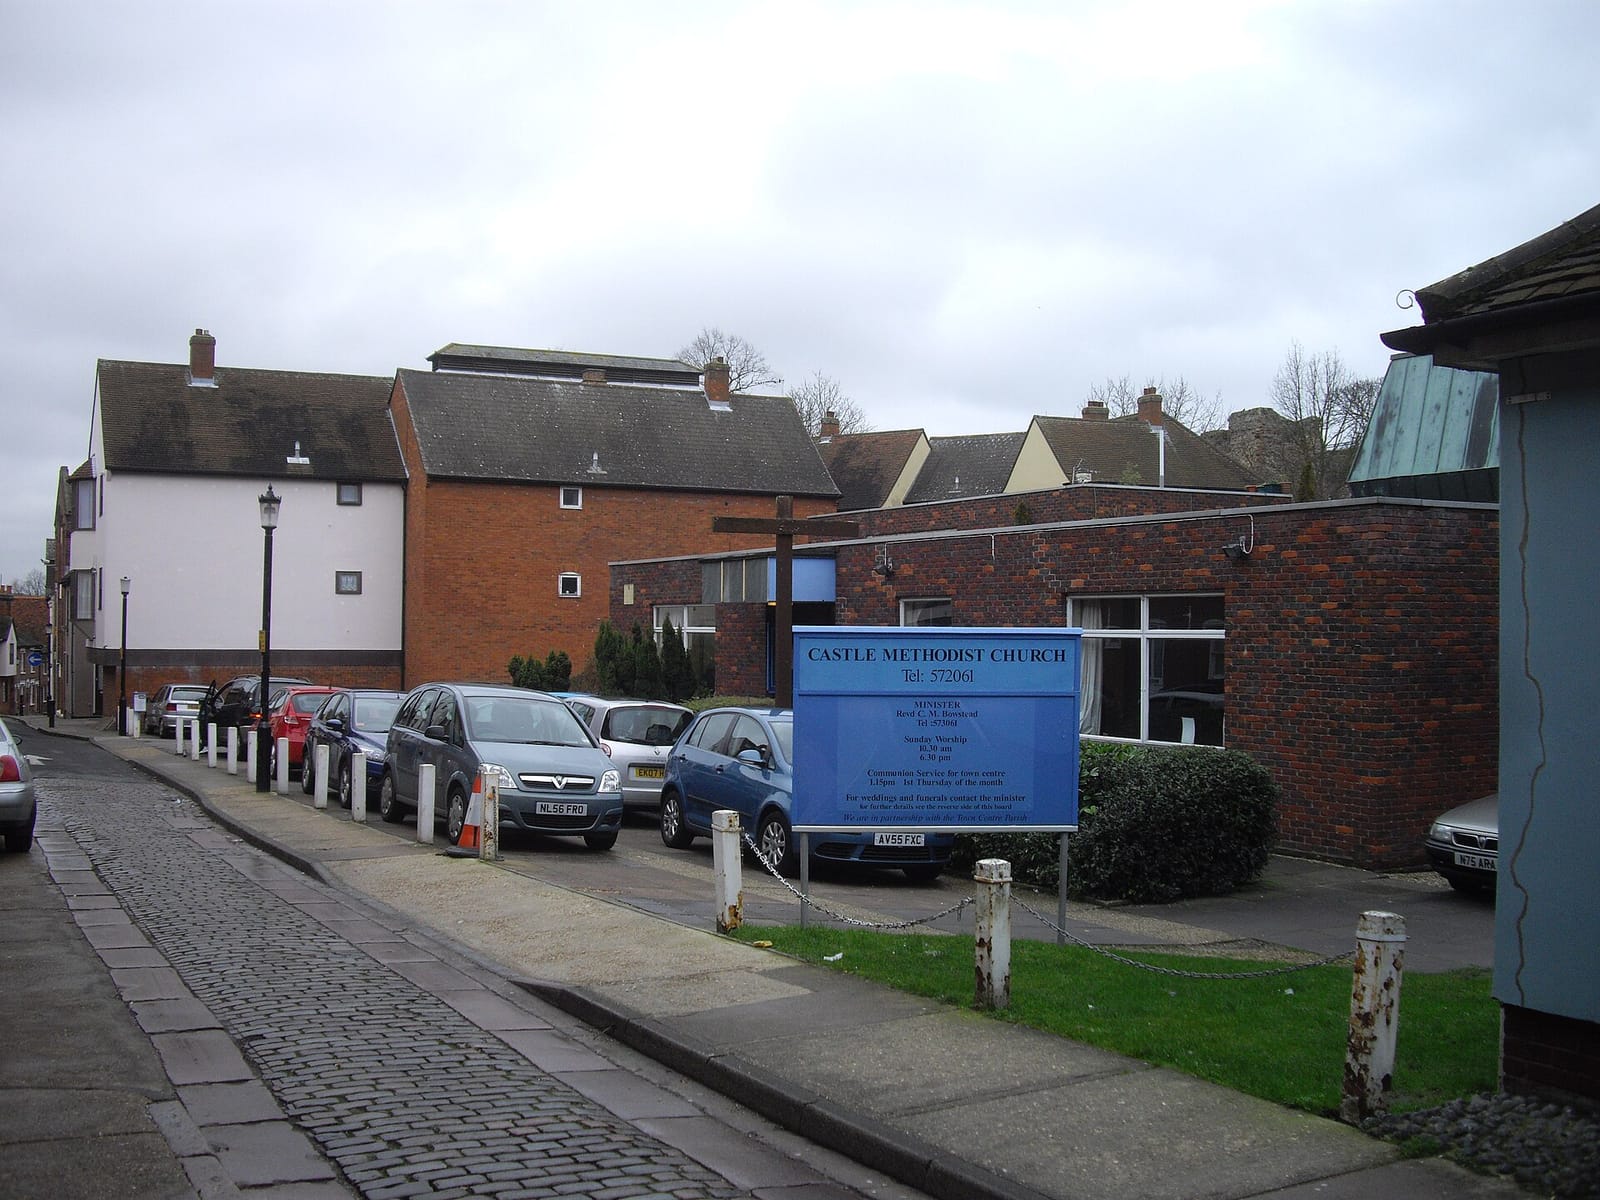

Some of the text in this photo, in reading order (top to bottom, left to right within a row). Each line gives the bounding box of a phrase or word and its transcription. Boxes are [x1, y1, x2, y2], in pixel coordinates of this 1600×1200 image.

[808, 648, 1067, 663] CASTLE METHODIST CHURCH
[901, 669, 974, 683] Tel: 572061
[914, 701, 961, 709] MINISTER
[896, 710, 915, 718] Revd
[942, 710, 978, 718] Bowstead
[904, 736, 968, 744] Sunday Worship
[638, 768, 658, 777] EK07
[867, 769, 1006, 777] Communion Service for town centre
[917, 779, 952, 787] Thursday
[861, 794, 897, 803] weddings
[540, 803, 584, 814] NL56 FRO
[878, 813, 924, 823] partnership
[924, 813, 941, 821] with
[943, 813, 954, 821] the
[957, 813, 976, 821] Town
[978, 813, 1003, 821] Centre
[878, 834, 922, 845] AV55 FXC
[1459, 854, 1477, 867] N75
